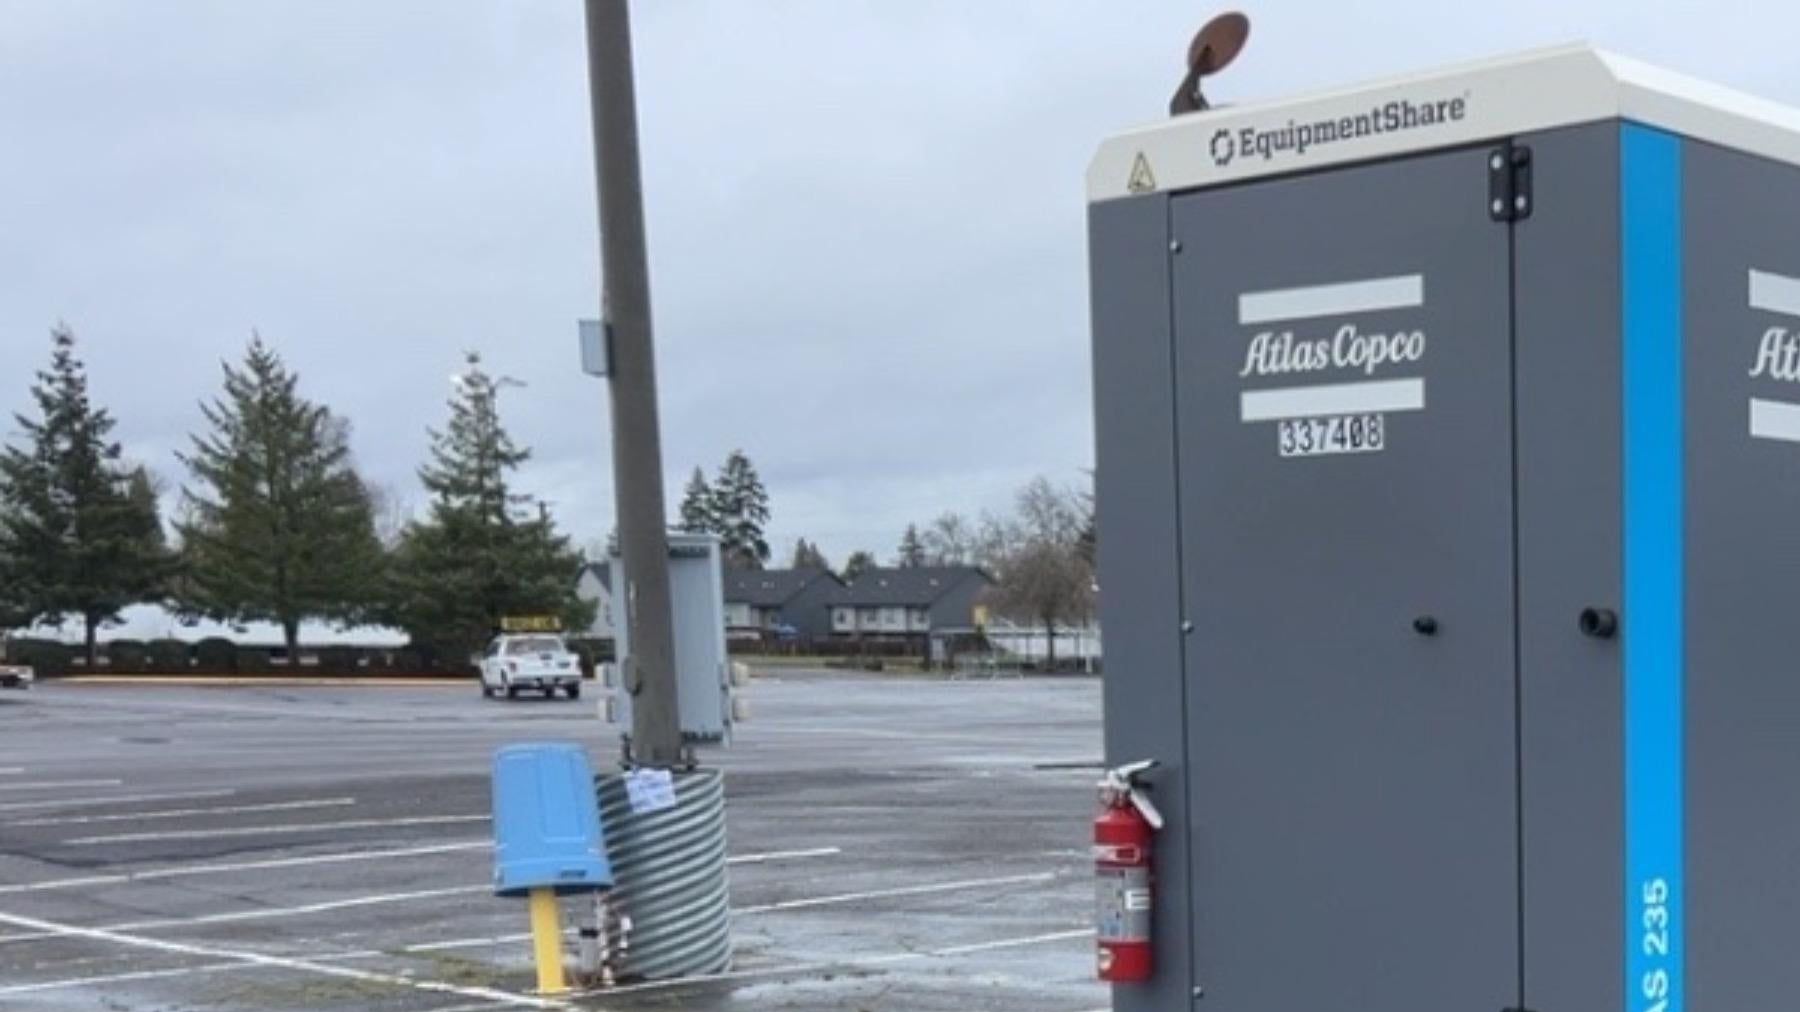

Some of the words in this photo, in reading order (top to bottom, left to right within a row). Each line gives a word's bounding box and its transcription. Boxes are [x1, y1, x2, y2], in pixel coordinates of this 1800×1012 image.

[1238, 97, 1466, 160] EquipmentShare
[1279, 414, 1383, 454] 337408
[1642, 877, 1669, 956] 235
